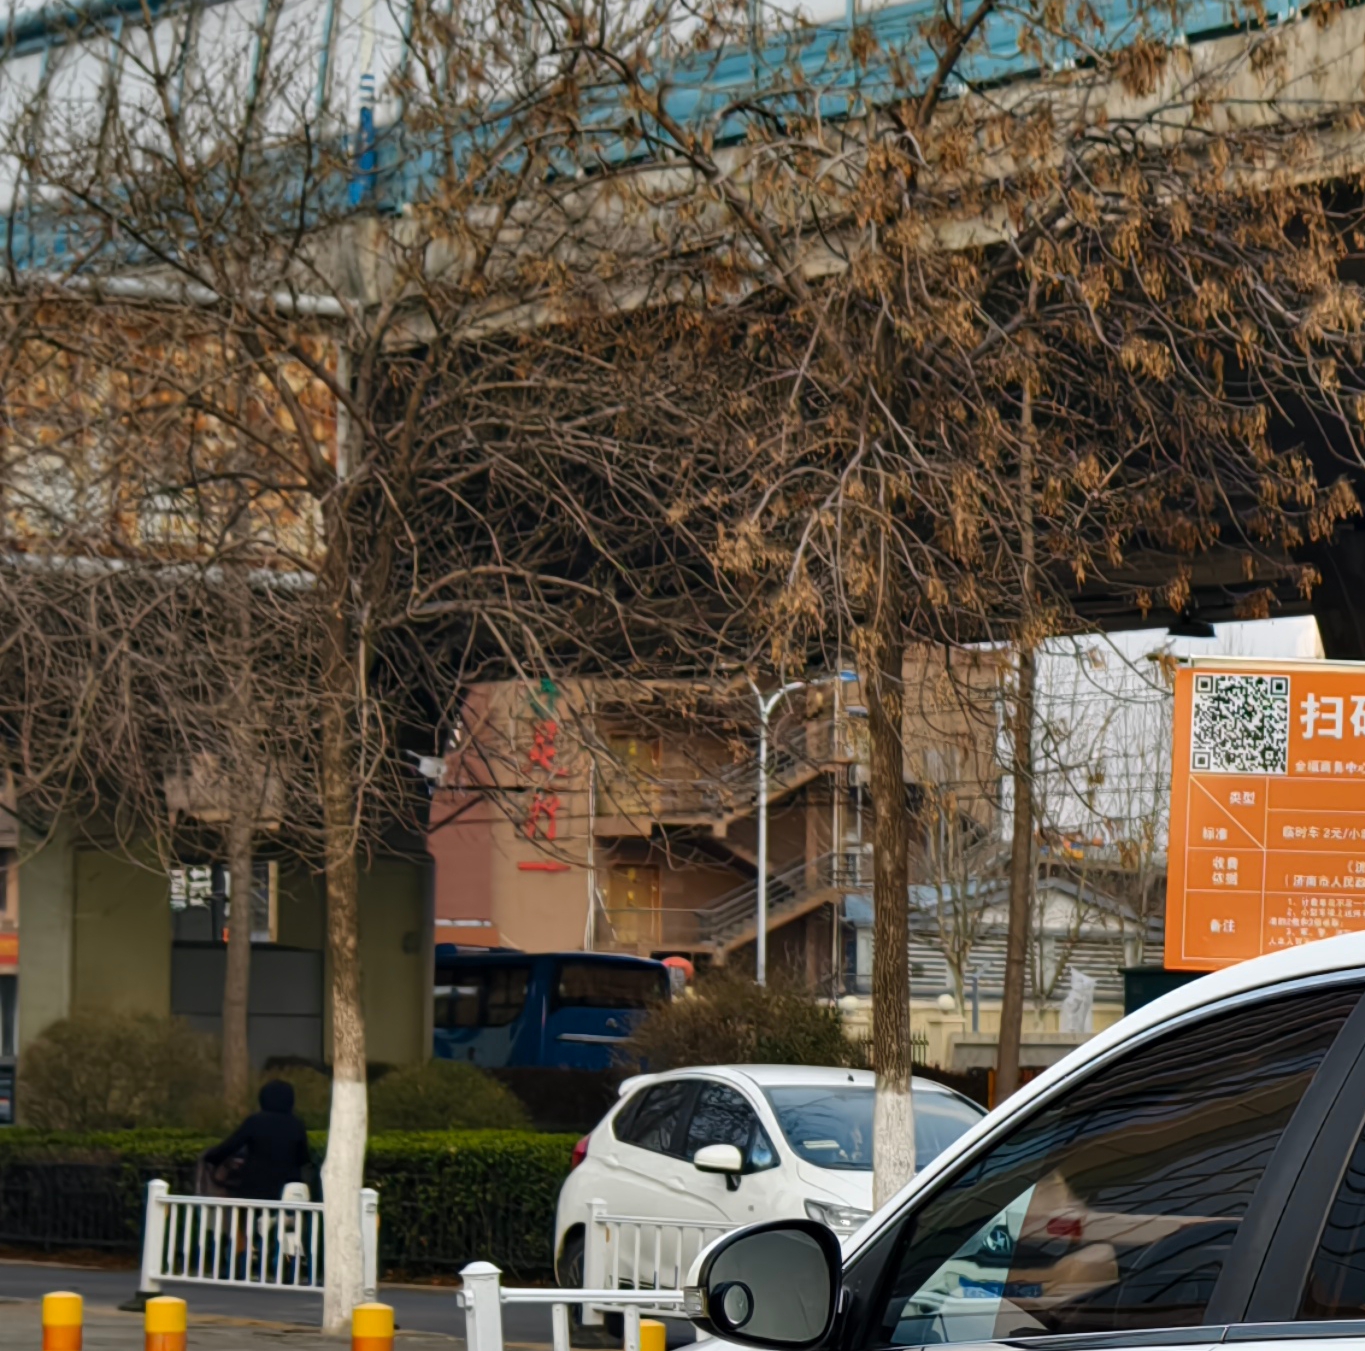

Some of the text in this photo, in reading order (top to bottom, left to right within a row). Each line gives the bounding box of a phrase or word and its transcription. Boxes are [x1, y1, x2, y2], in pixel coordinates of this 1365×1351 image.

[1229, 791, 1255, 805] 类型
[1202, 826, 1228, 841] 标准
[1212, 856, 1238, 871] 收费
[1209, 918, 1236, 933] 备注
